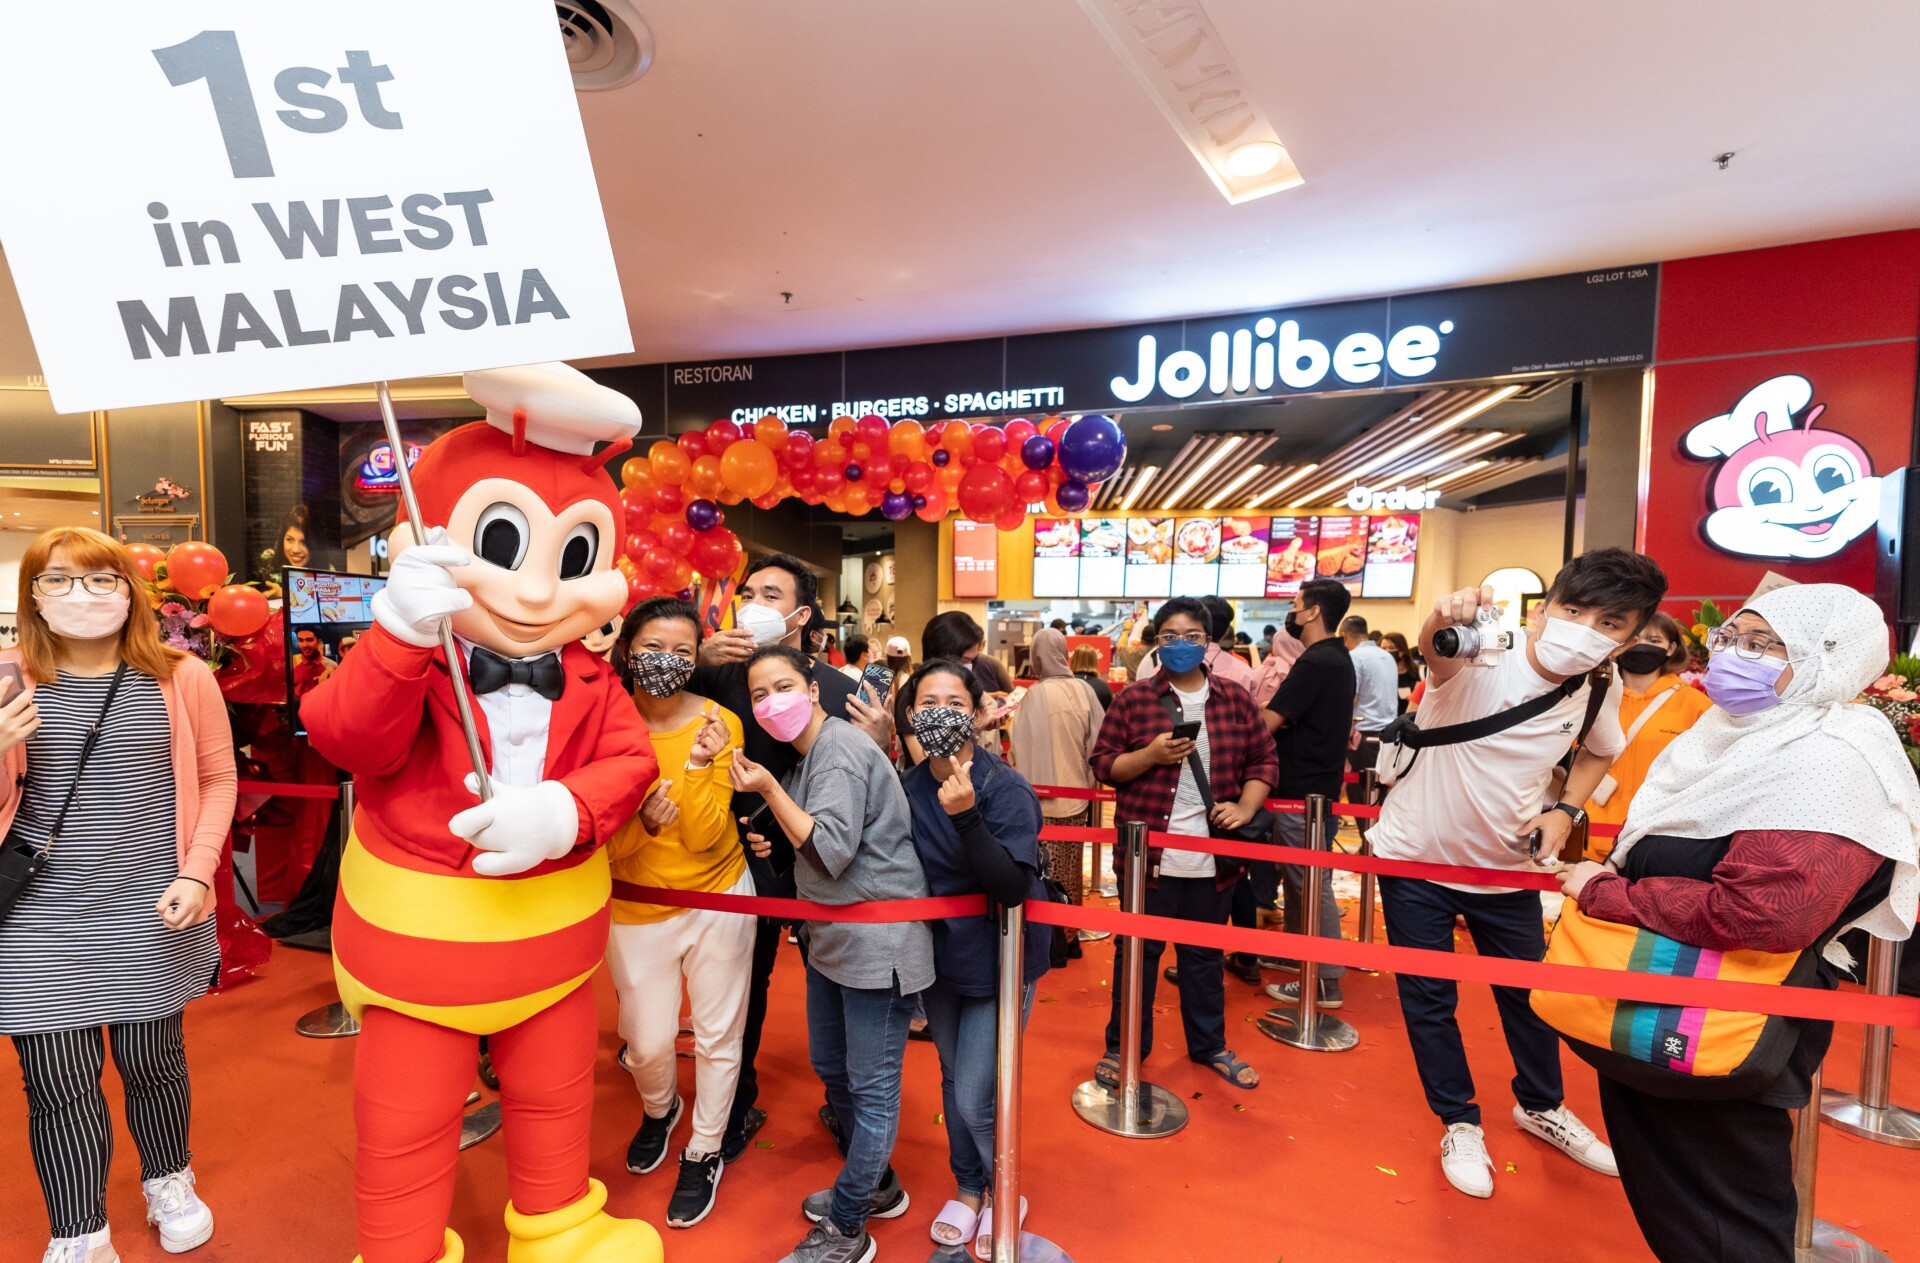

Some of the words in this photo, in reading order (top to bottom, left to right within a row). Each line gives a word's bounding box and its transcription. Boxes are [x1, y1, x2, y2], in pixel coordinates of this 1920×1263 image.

[151, 30, 403, 178] 1st
[146, 201, 240, 268] in
[251, 188, 494, 261] WEST
[1586, 274, 1604, 284] LG2
[1606, 272, 1625, 281] LOT
[1627, 269, 1648, 279] 126A
[116, 268, 570, 361] MALAYSIA
[1110, 317, 1442, 403] Jollibee
[674, 364, 753, 385] RESTORAN
[832, 396, 929, 420] BURGERS
[944, 386, 1064, 413] SPAGHETTI
[248, 433, 294, 441] FURIOUS
[250, 421, 292, 433] FAST
[255, 441, 288, 452] FUN
[1347, 485, 1441, 511] Order
